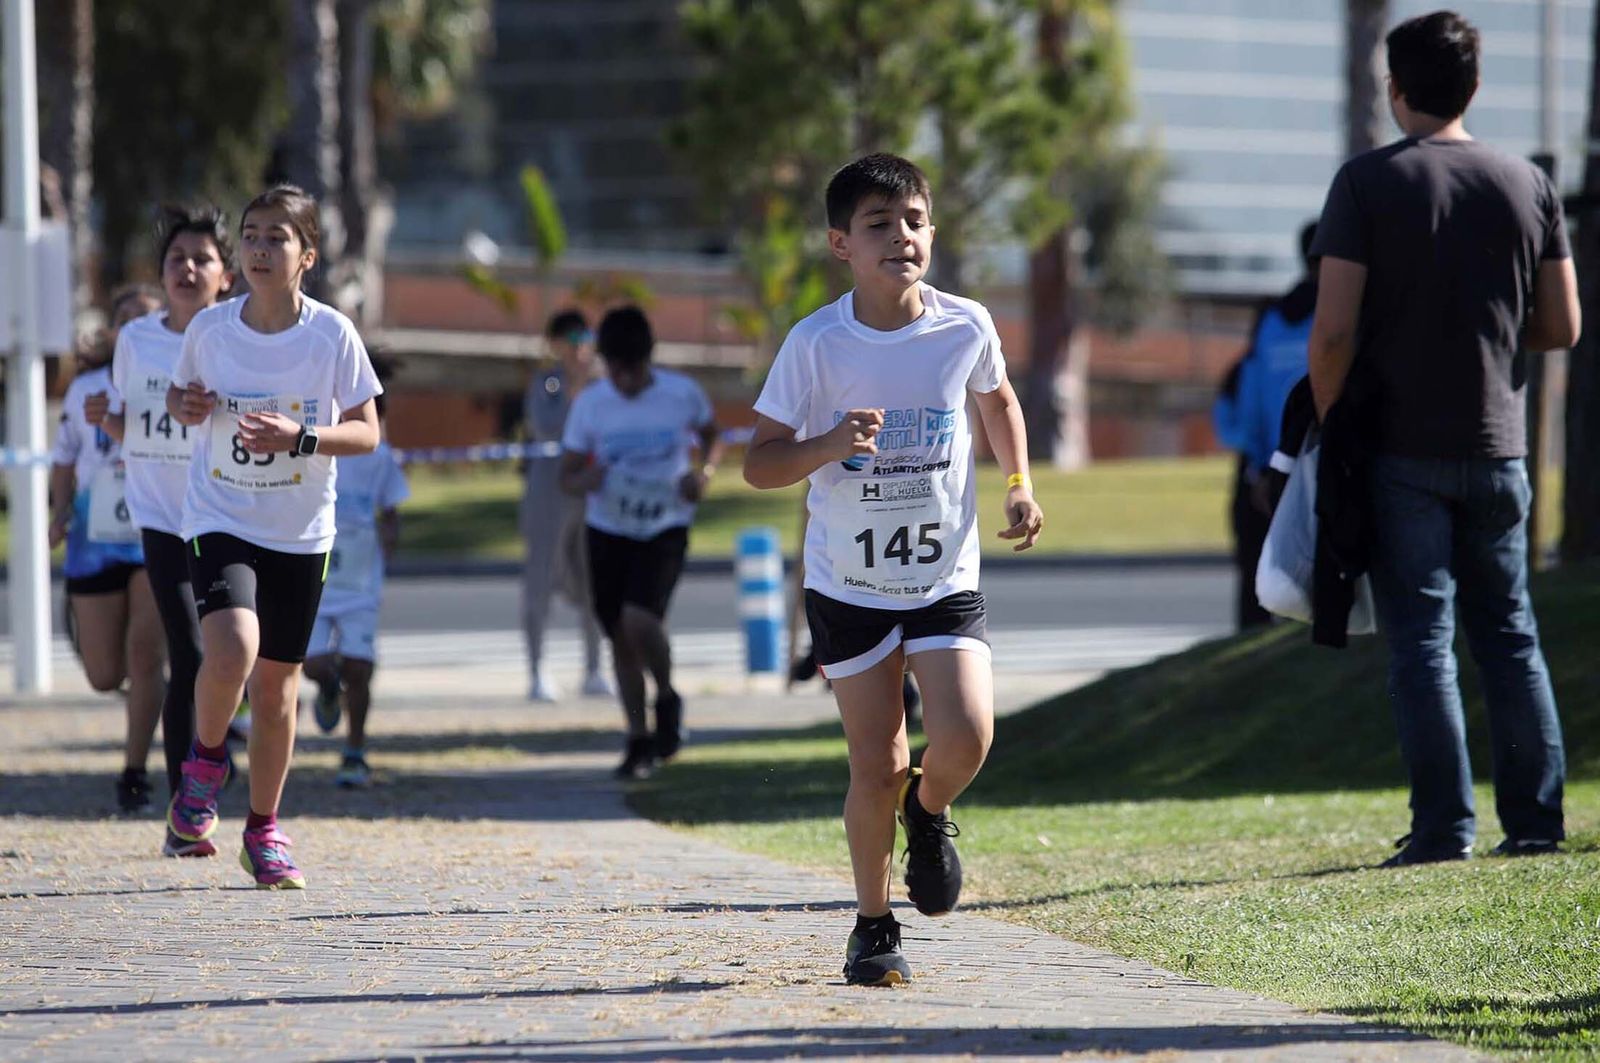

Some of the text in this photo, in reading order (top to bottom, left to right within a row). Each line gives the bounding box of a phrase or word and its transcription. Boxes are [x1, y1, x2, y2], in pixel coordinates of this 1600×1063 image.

[227, 398, 238, 411] H
[926, 414, 954, 431] kilos
[926, 435, 934, 447] x
[873, 463, 920, 476] ATLANTIC
[862, 483, 880, 498] H
[898, 485, 931, 495] HUELVA
[854, 522, 943, 569] 145
[843, 575, 877, 591] Huelva
[903, 586, 919, 595] tus
